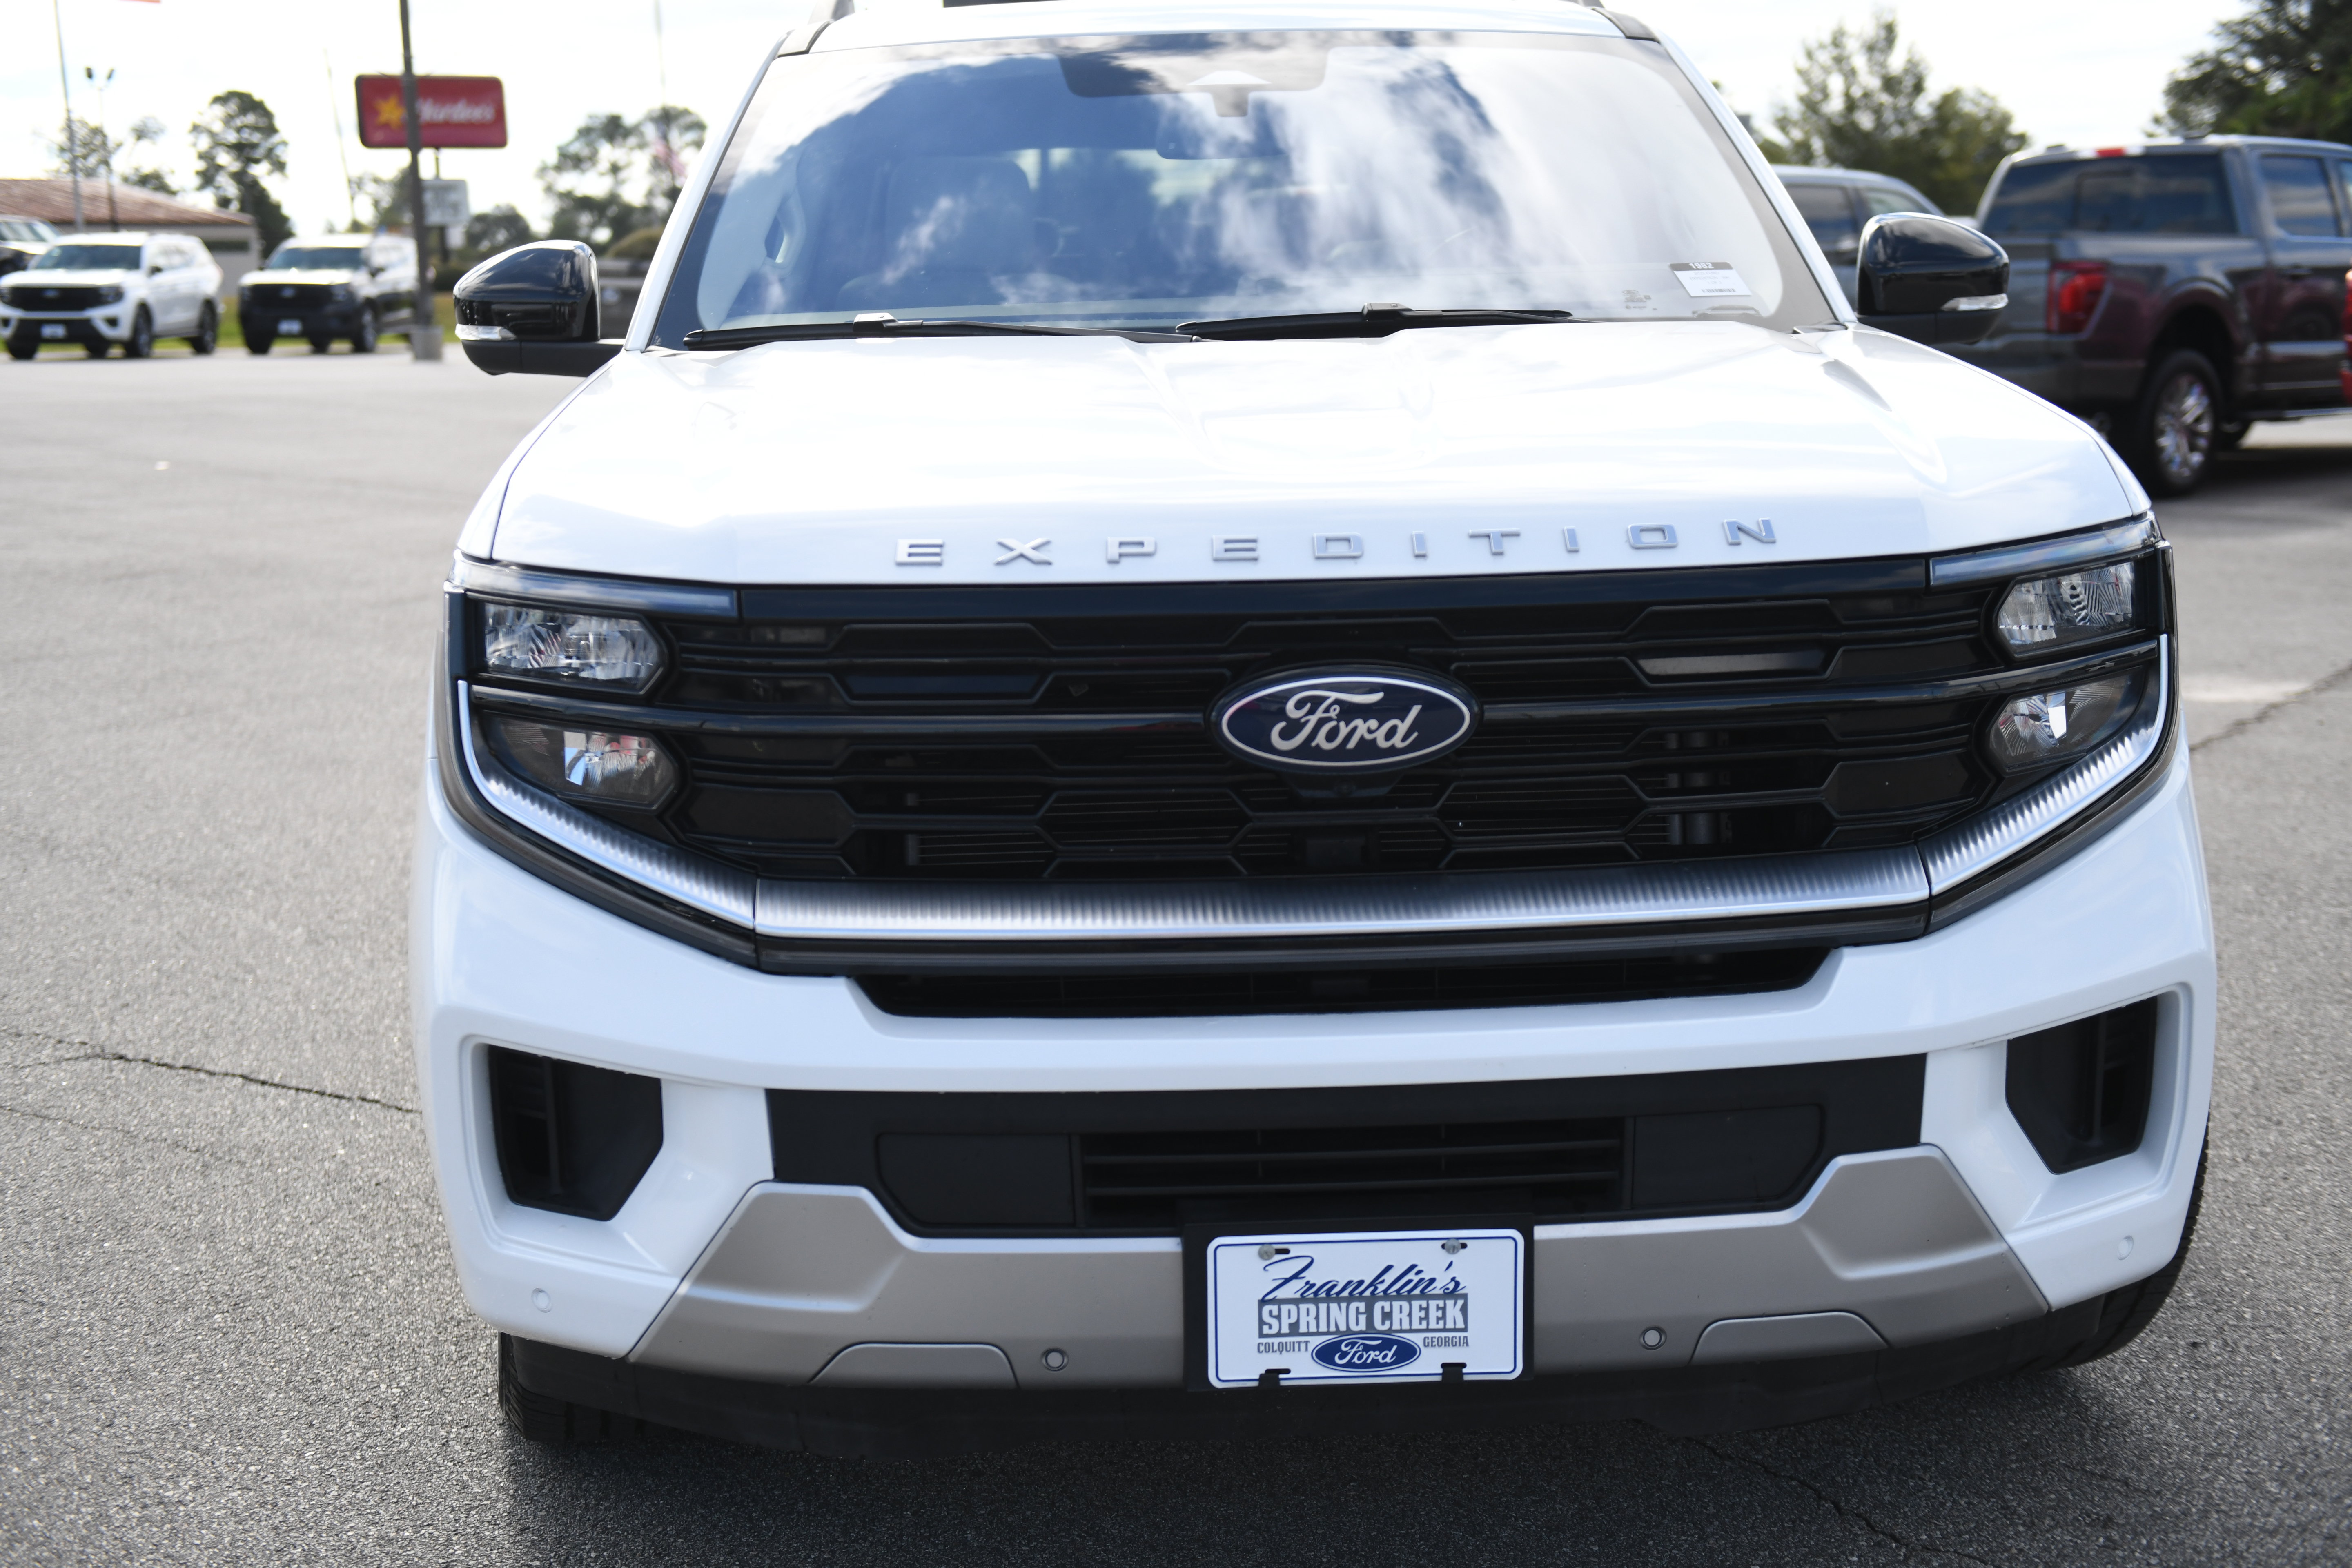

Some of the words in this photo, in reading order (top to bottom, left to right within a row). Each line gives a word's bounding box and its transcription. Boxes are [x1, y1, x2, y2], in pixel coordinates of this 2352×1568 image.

[895, 517, 1777, 566] EXPEDITION
[1270, 690, 1423, 751] Ford
[1261, 1255, 1467, 1303] Franklin's
[1262, 1301, 1367, 1335] SPRING
[1373, 1299, 1466, 1331] CREEK
[1257, 1341, 1310, 1354] COLQUITT
[1334, 1339, 1398, 1365] Ford
[1423, 1336, 1469, 1348] GEORGIA
